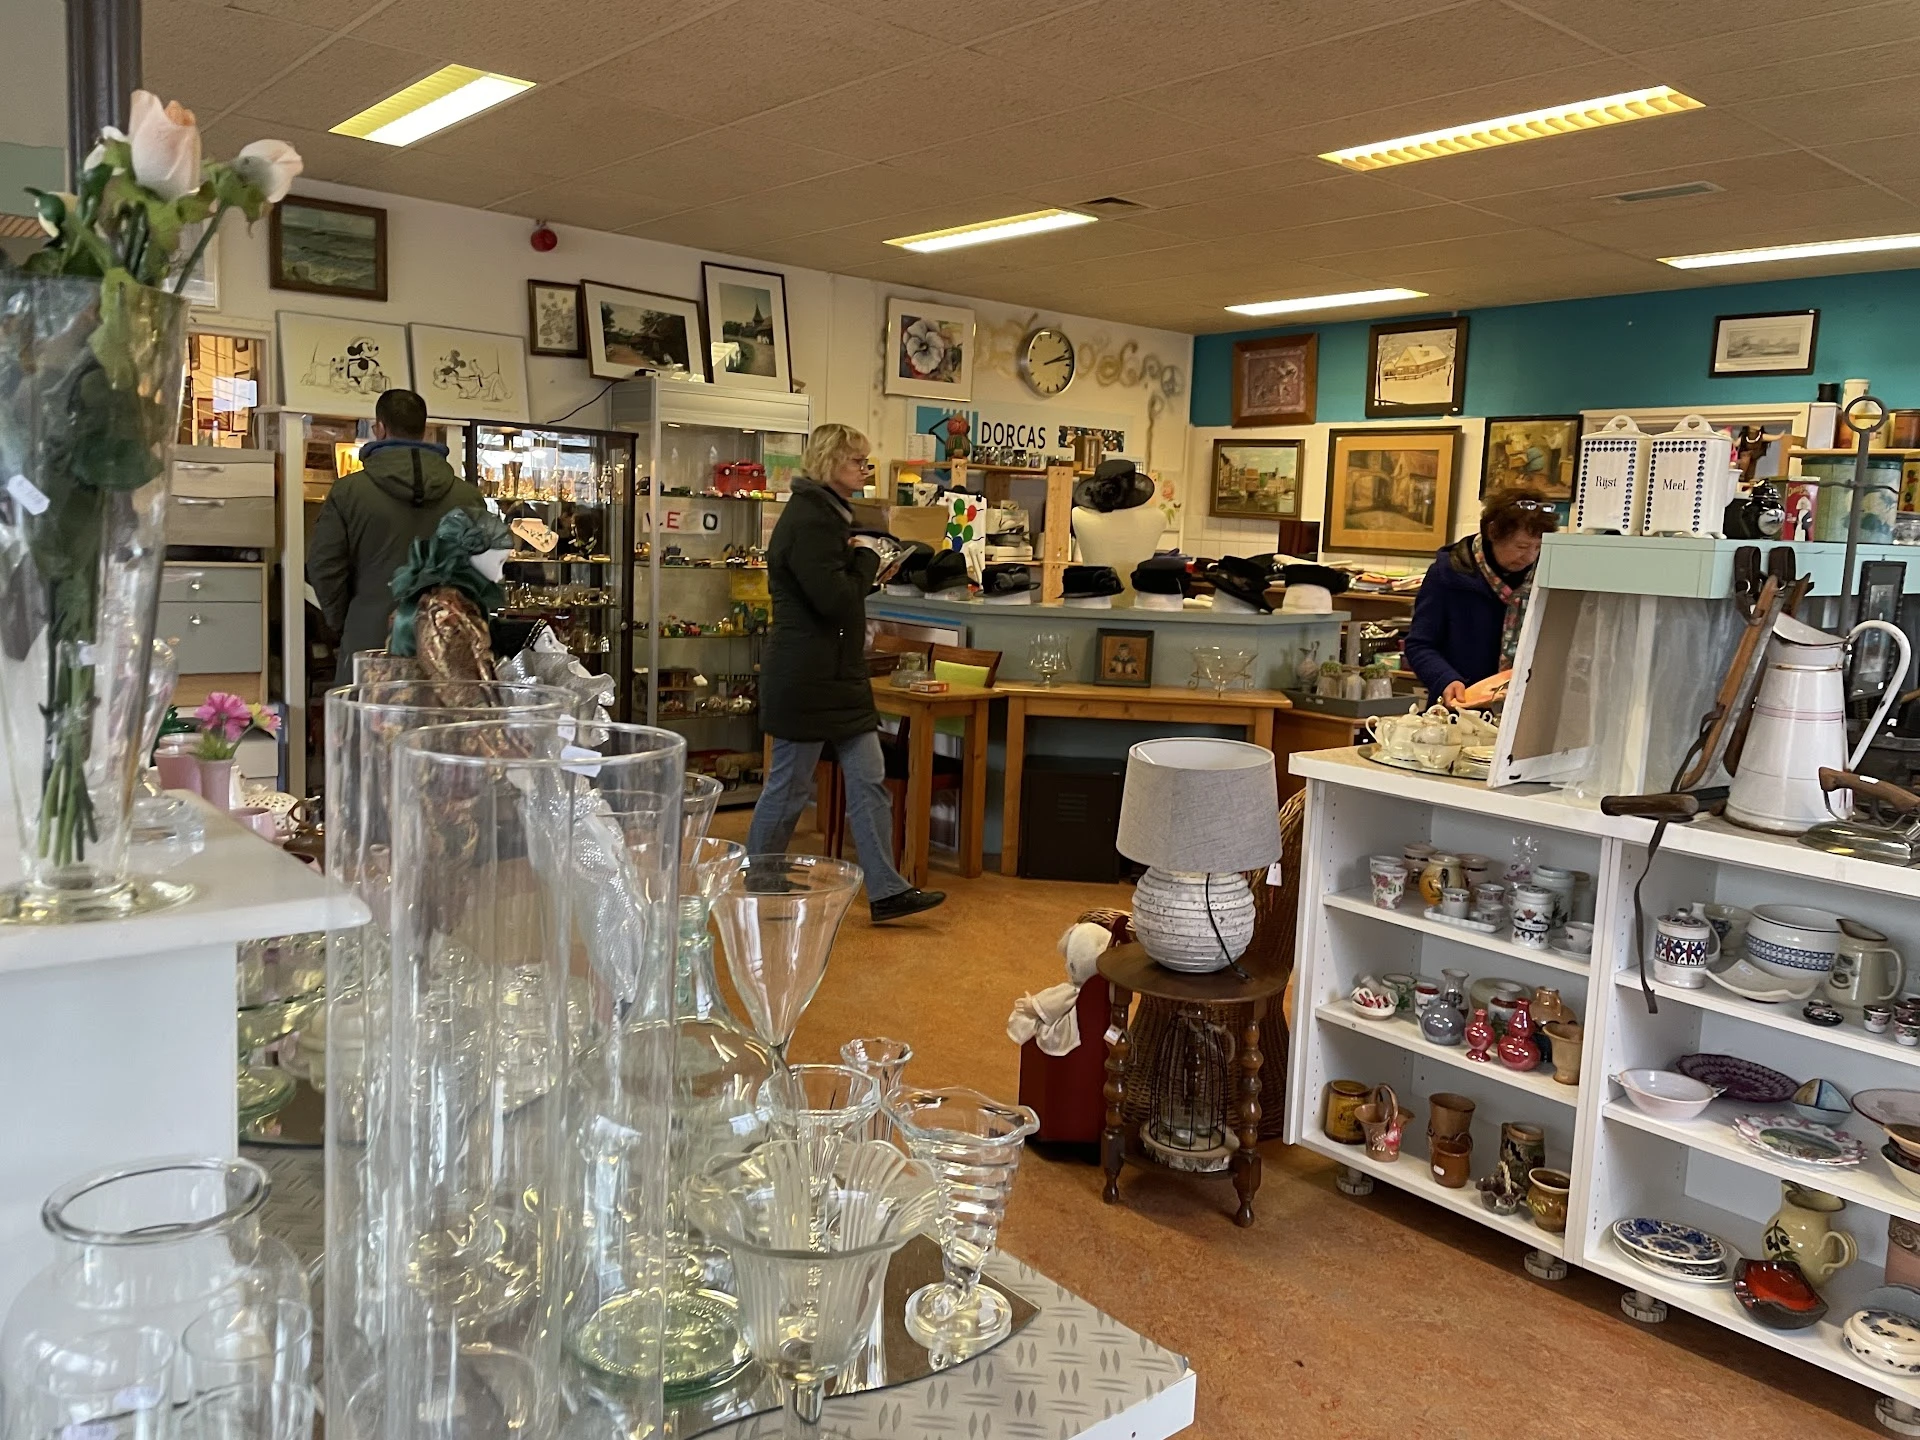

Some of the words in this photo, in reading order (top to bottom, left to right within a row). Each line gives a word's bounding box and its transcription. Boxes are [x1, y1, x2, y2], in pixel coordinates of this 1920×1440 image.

[981, 421, 1047, 449] DORCAS
[1595, 475, 1617, 490] Rijst
[645, 511, 719, 531] LEO
